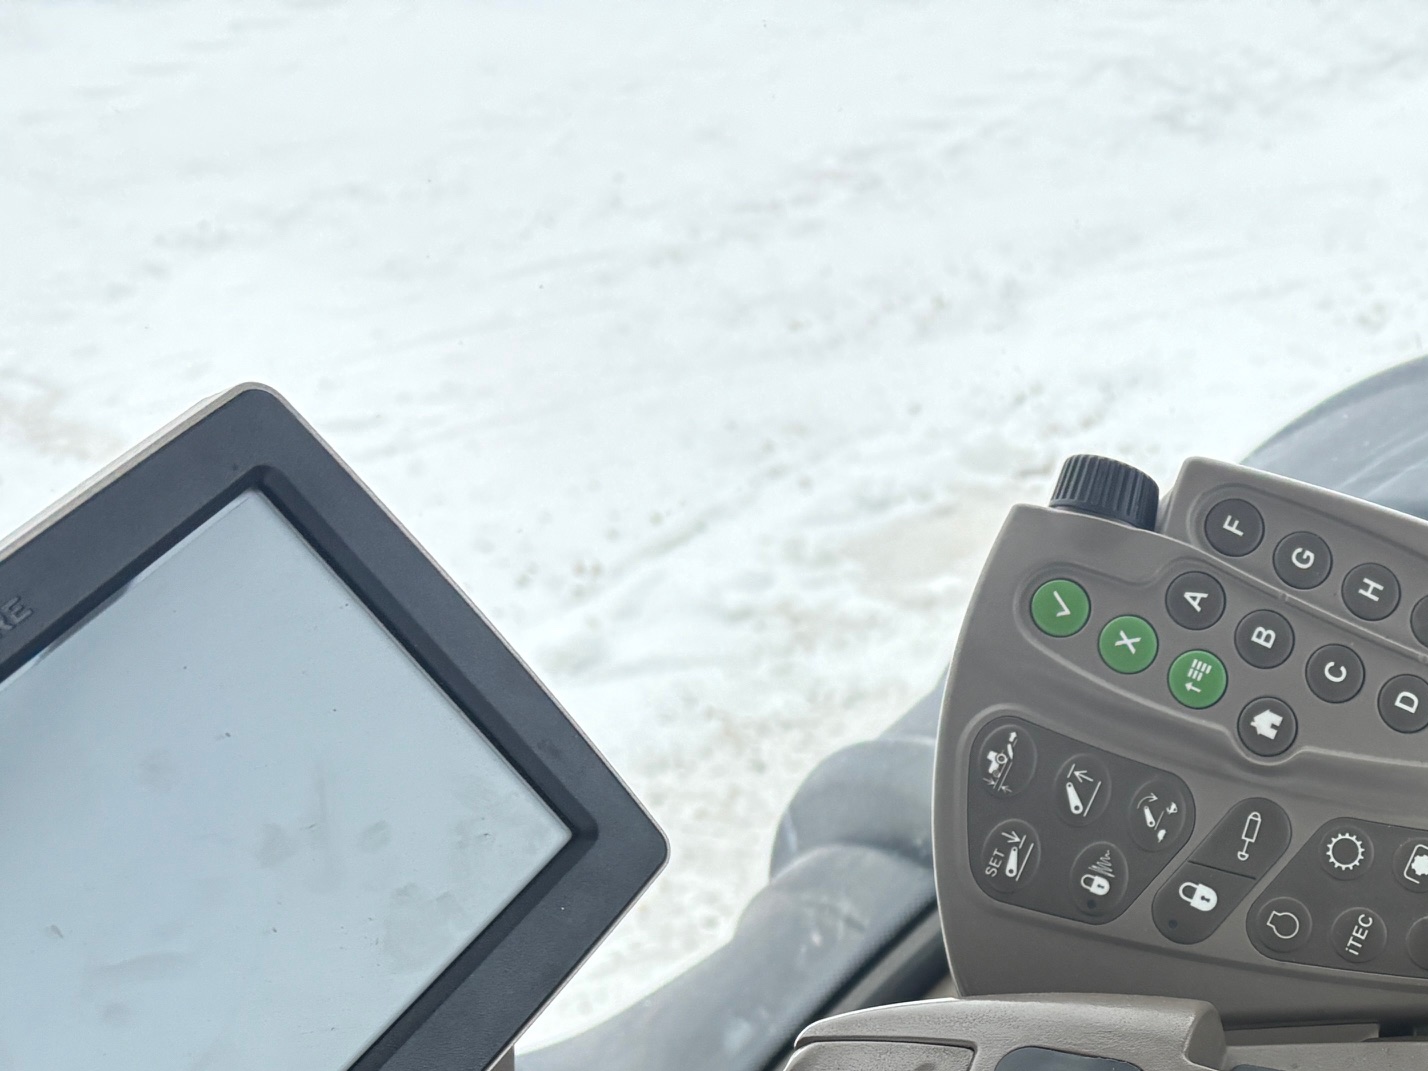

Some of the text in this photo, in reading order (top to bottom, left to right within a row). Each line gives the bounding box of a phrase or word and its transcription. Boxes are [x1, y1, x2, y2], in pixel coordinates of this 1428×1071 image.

[1222, 515, 1244, 537] F
[1291, 547, 1315, 569] G
[1358, 577, 1384, 602] H
[1183, 591, 1209, 612] A
[1250, 626, 1276, 649] B
[1324, 661, 1347, 683] C
[1394, 691, 1419, 714] D
[984, 848, 1005, 877] SET
[1345, 913, 1373, 955] iTEC
